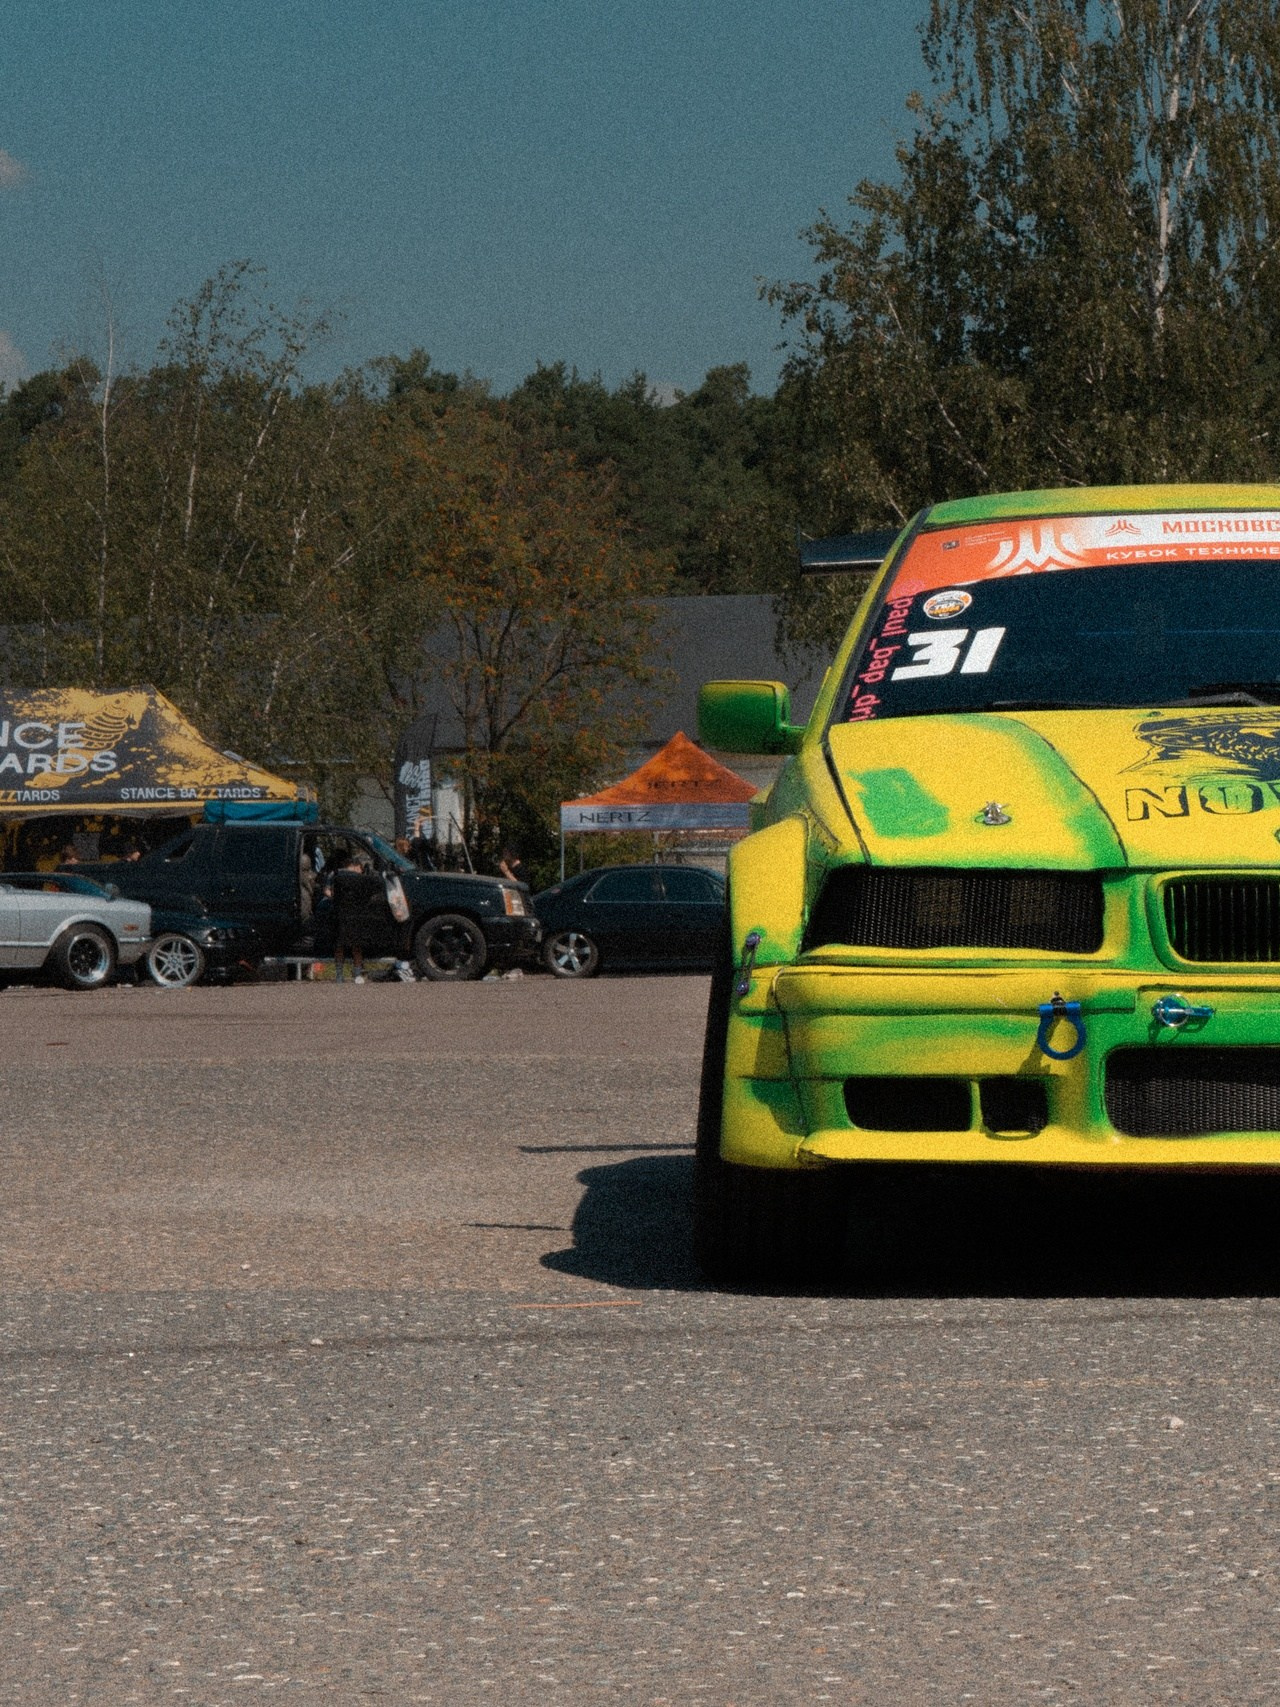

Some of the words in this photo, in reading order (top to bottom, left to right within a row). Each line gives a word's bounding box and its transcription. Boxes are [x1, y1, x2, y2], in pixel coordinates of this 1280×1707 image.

[1106, 547, 1178, 560] КУБОК
[891, 627, 1006, 681] 31
[120, 787, 176, 799] STANCE
[179, 787, 261, 799] BAZZTARDS
[579, 811, 651, 824] HERTZ
